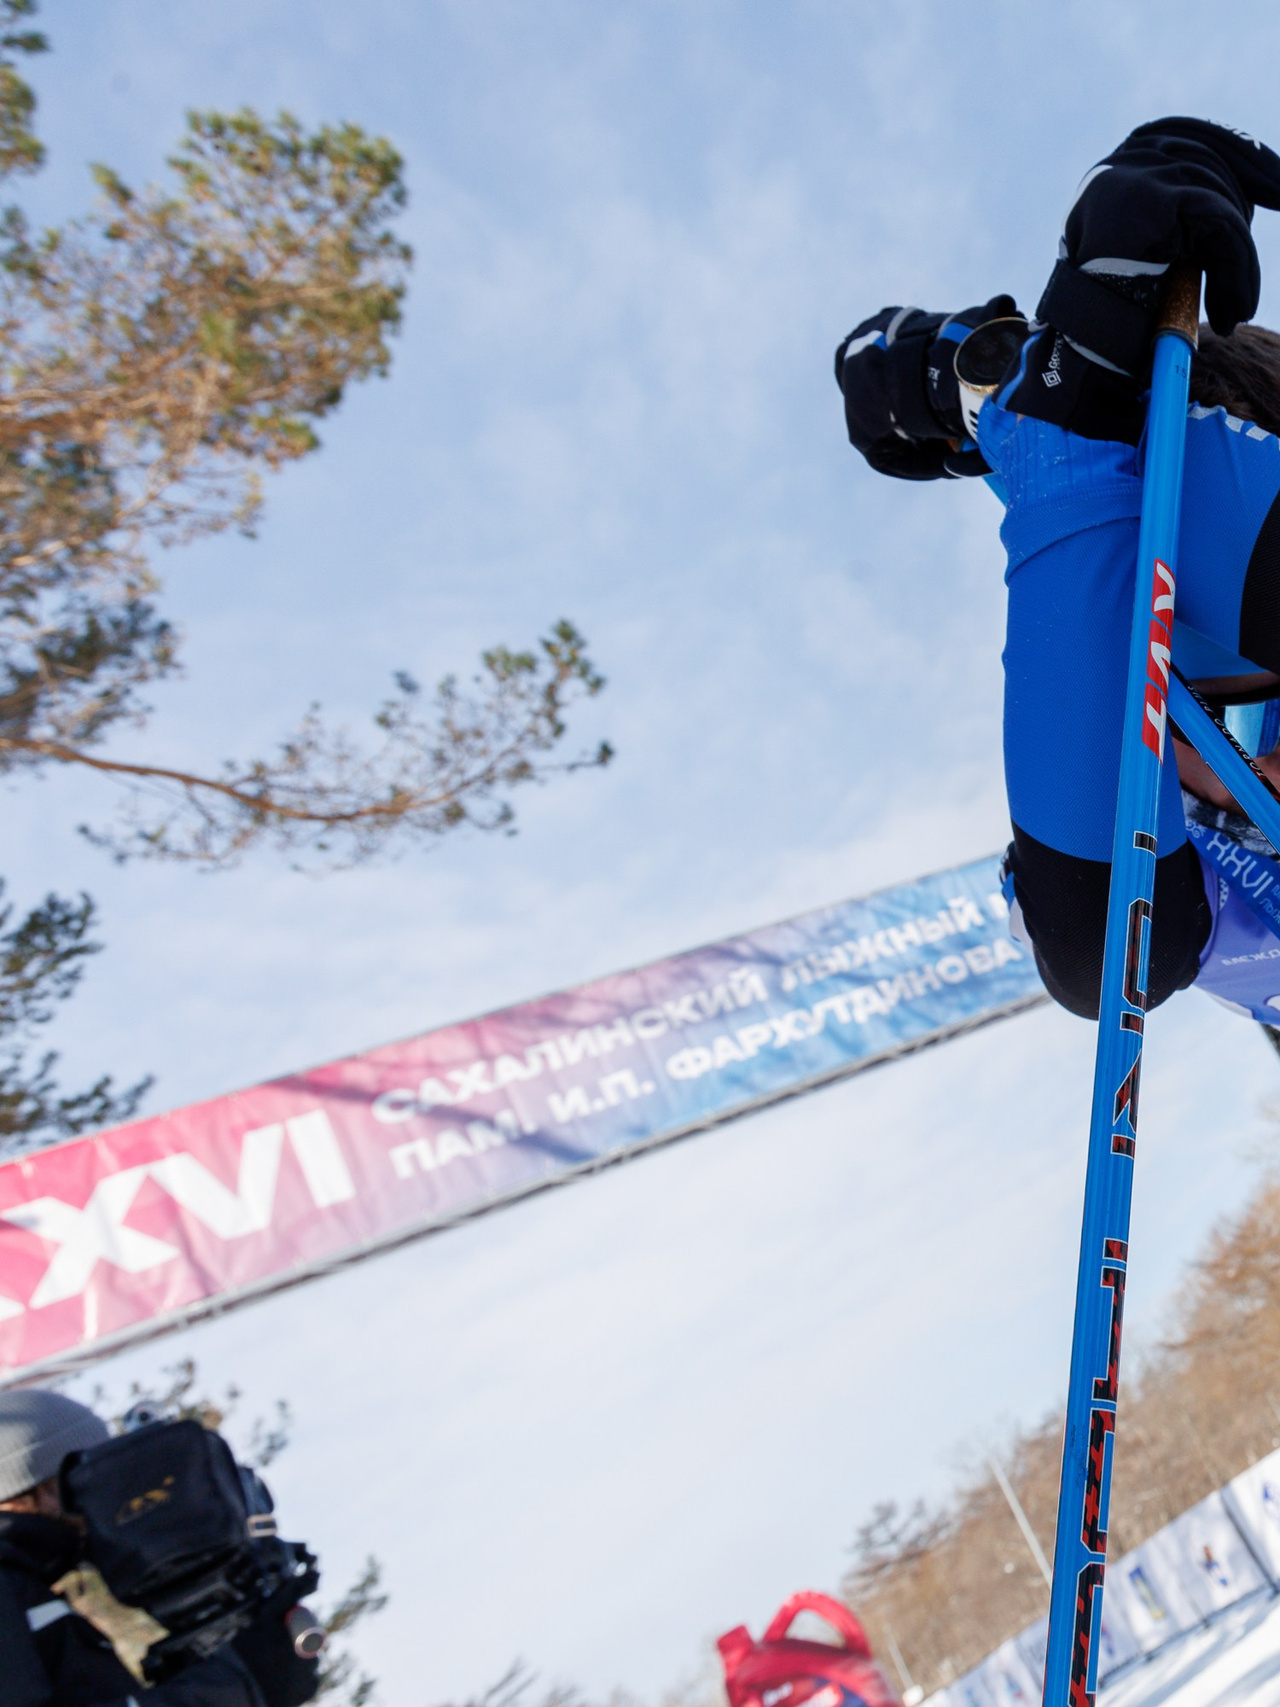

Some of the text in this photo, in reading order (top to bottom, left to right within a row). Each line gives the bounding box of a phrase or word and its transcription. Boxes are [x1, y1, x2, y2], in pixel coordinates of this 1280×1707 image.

[1206, 831, 1275, 899] XXVI
[371, 896, 985, 1124] САХАЛИНСКИЙ ЛЫЖНЫЙ
[387, 937, 1023, 1180] ПАМ. И.П. ФАРХУТДИНОВА
